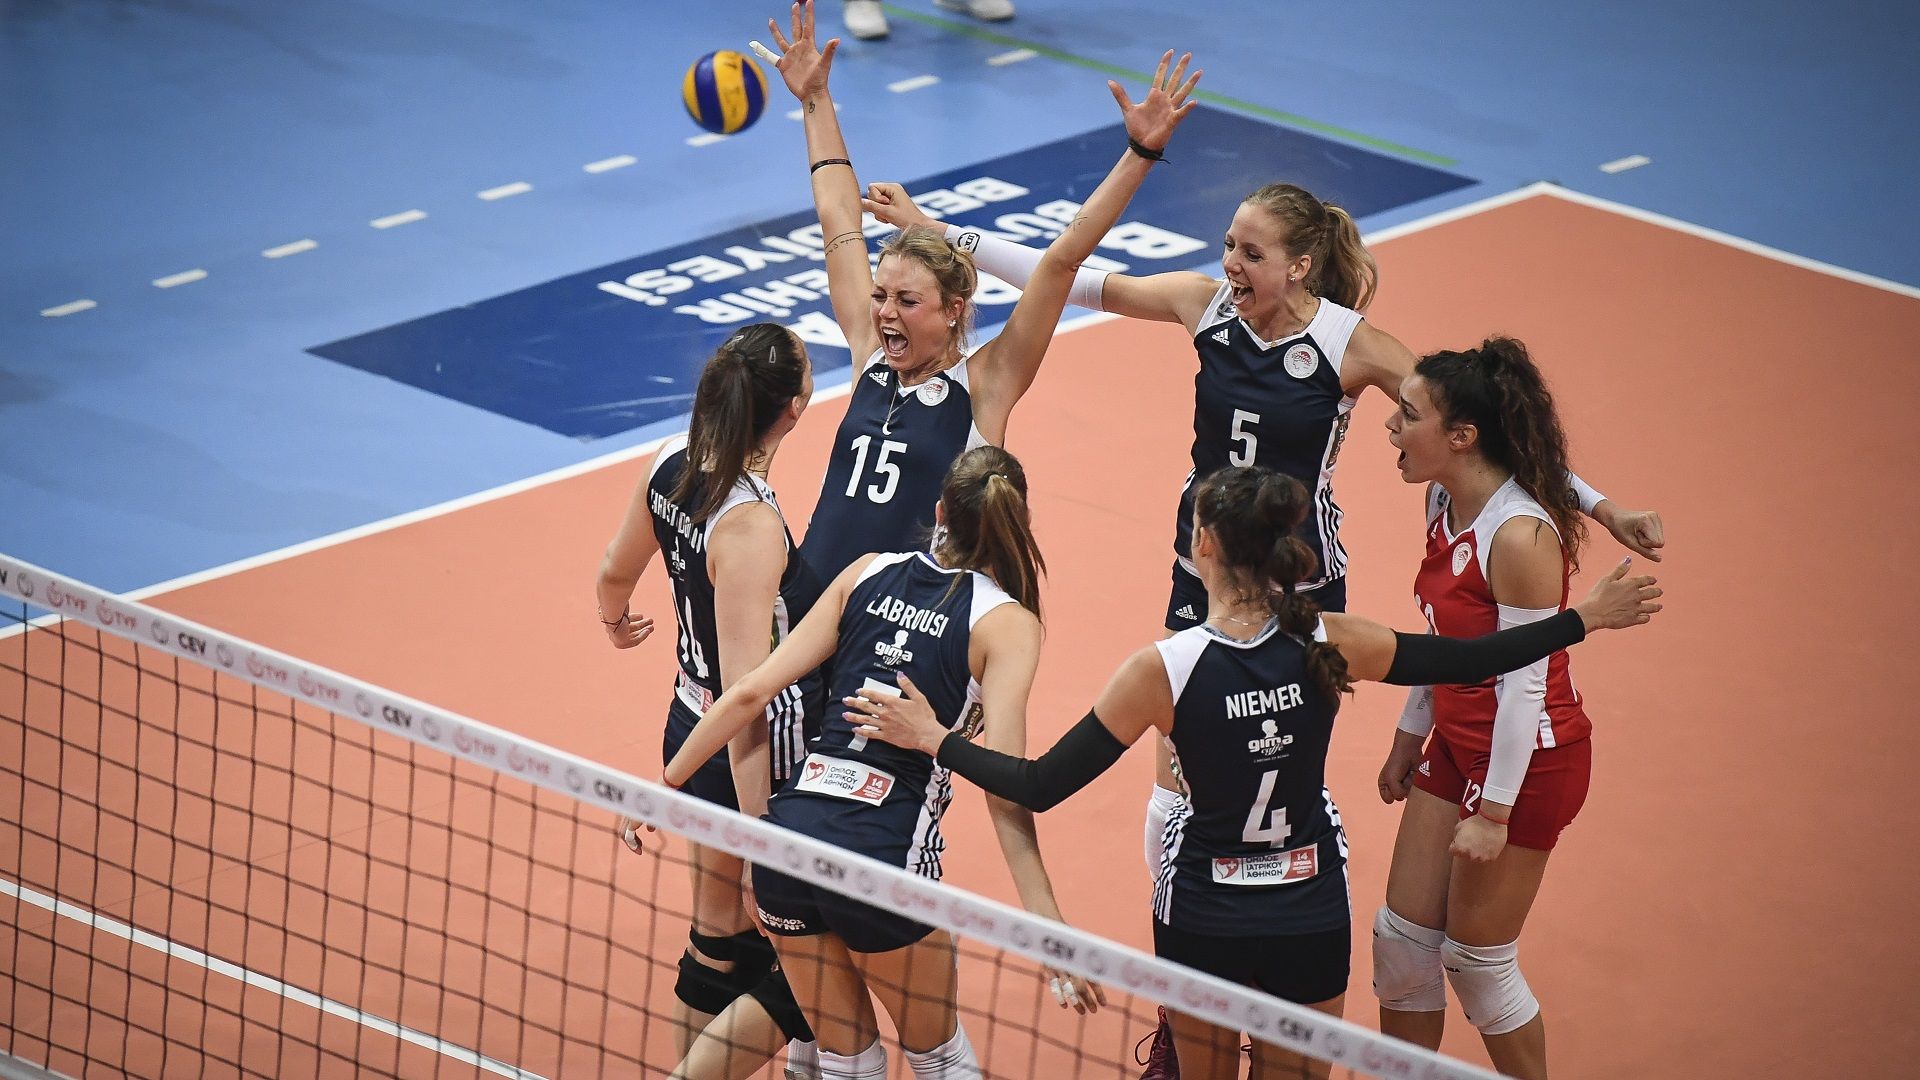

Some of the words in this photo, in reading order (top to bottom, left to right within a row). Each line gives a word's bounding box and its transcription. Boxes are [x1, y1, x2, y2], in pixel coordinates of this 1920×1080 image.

[1228, 408, 1261, 467] 5
[845, 434, 908, 504] 15
[865, 592, 949, 639] LABROUSI
[1175, 610, 1198, 621] adidas
[66, 592, 88, 612] TVF
[115, 611, 138, 630] TVF
[177, 630, 207, 655] CEV
[263, 664, 289, 682] TVF
[382, 705, 412, 728] CEV
[874, 641, 914, 663] gima
[1225, 683, 1304, 720] NIEMER
[1247, 734, 1294, 753] gima
[1241, 769, 1292, 849] 4
[1462, 778, 1482, 813] 12
